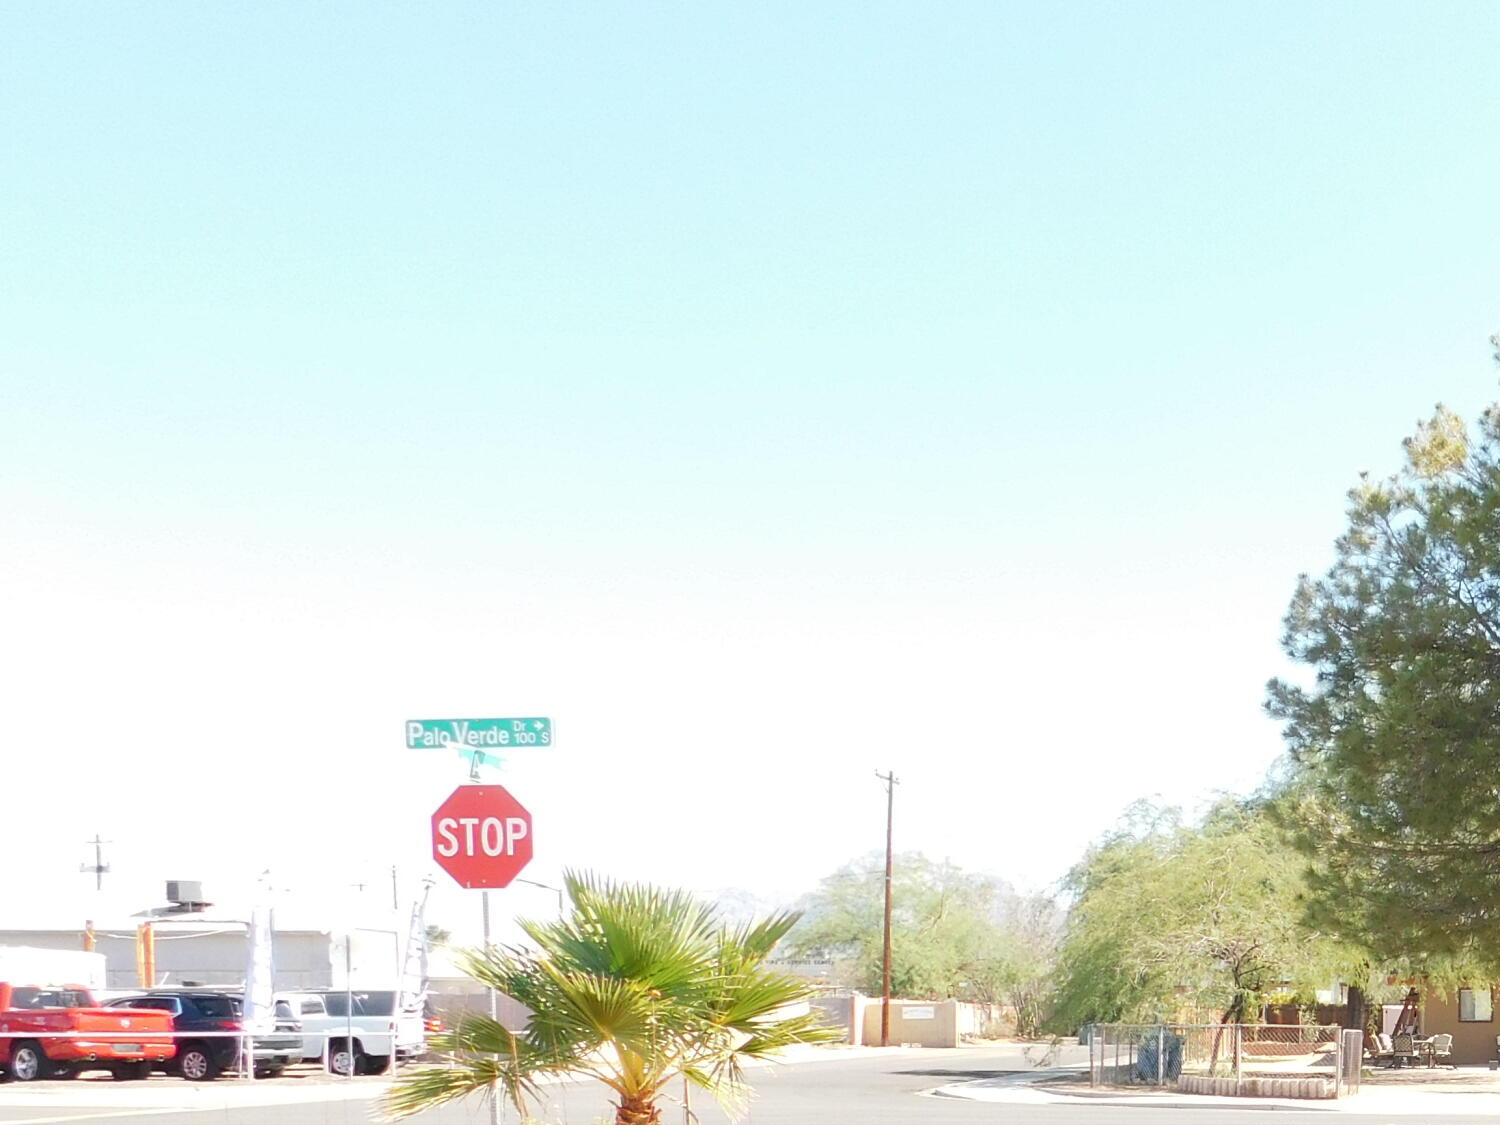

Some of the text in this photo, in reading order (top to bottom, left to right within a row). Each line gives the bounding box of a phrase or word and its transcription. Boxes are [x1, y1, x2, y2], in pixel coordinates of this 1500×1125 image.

[408, 721, 525, 746] Palo Verde Dr
[514, 732, 550, 744] 100 S
[437, 817, 527, 857] STOP
